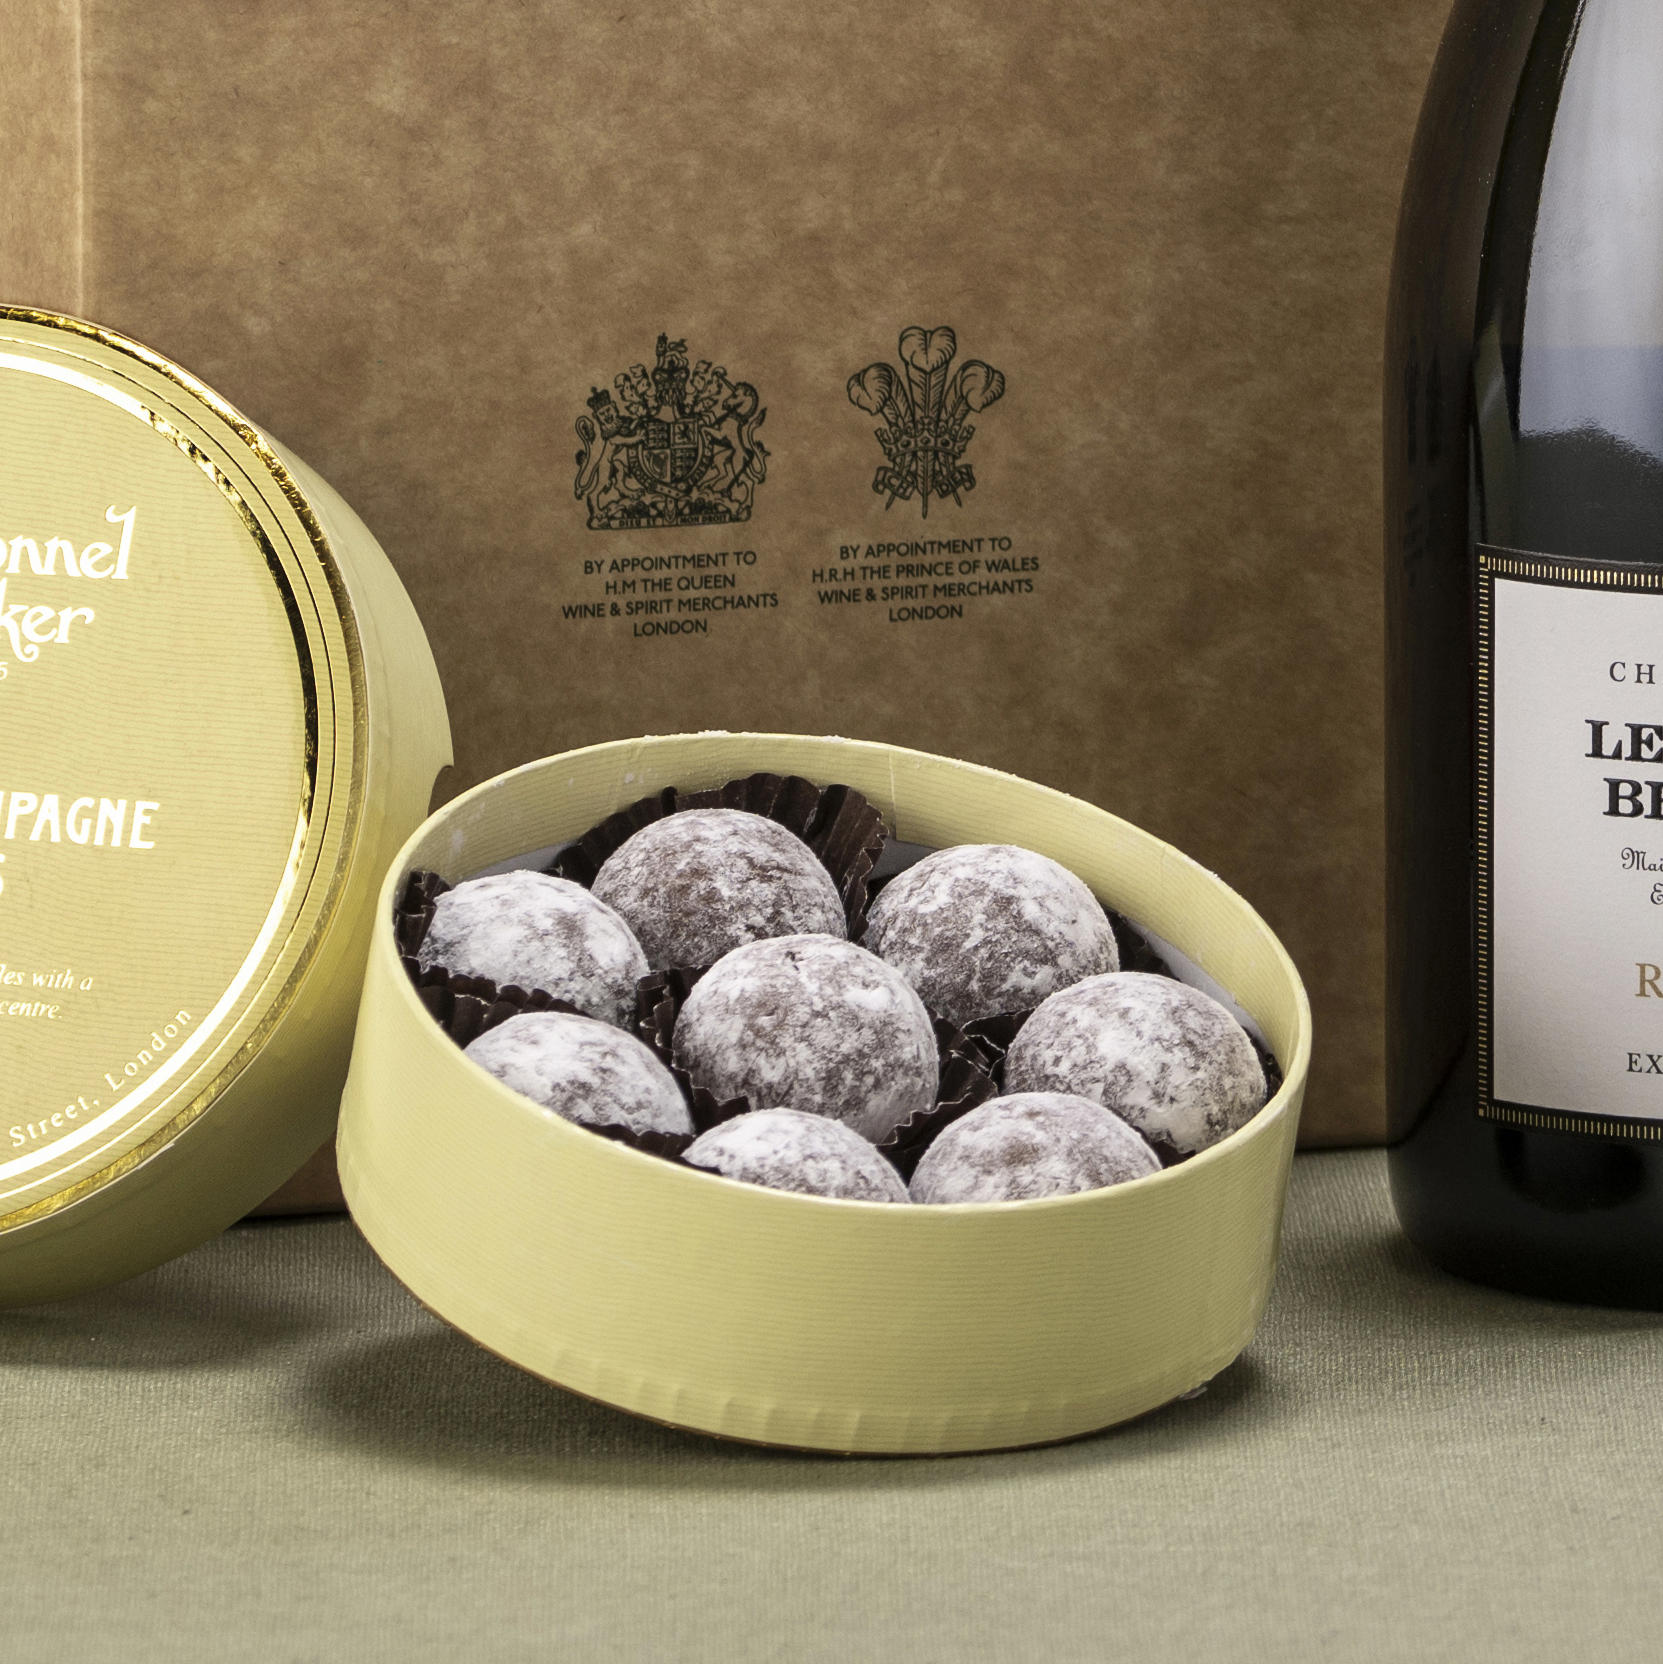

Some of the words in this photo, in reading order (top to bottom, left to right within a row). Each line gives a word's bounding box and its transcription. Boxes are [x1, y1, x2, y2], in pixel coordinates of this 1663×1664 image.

[840, 545, 860, 560] BY
[865, 538, 984, 558] APPOINTMENT
[988, 536, 1012, 552] TO
[584, 560, 604, 574] BY
[609, 552, 729, 573] APPOINTMENT
[733, 551, 757, 565] TO
[812, 567, 855, 583] H.R.H
[859, 565, 891, 580] THE
[896, 562, 954, 578] PRINCE
[958, 560, 981, 575] OF
[985, 556, 1039, 573] WALES
[606, 579, 636, 595] H.M
[640, 578, 672, 593] THE
[677, 574, 735, 591] QUEEN
[818, 588, 861, 604] WINE
[865, 588, 876, 602] &
[881, 584, 928, 601] SPIRIT
[933, 578, 1033, 598] MERCHANTS
[562, 603, 605, 619] WINE
[610, 602, 621, 616] &
[626, 599, 673, 615] SPIRIT
[678, 592, 778, 612] MERCHANTS
[889, 604, 963, 622] LONDON
[634, 619, 707, 638] LONDON
[33, 969, 73, 988] with
[80, 977, 92, 990] a
[9, 1095, 100, 1147] Street,
[104, 1009, 190, 1091] London
